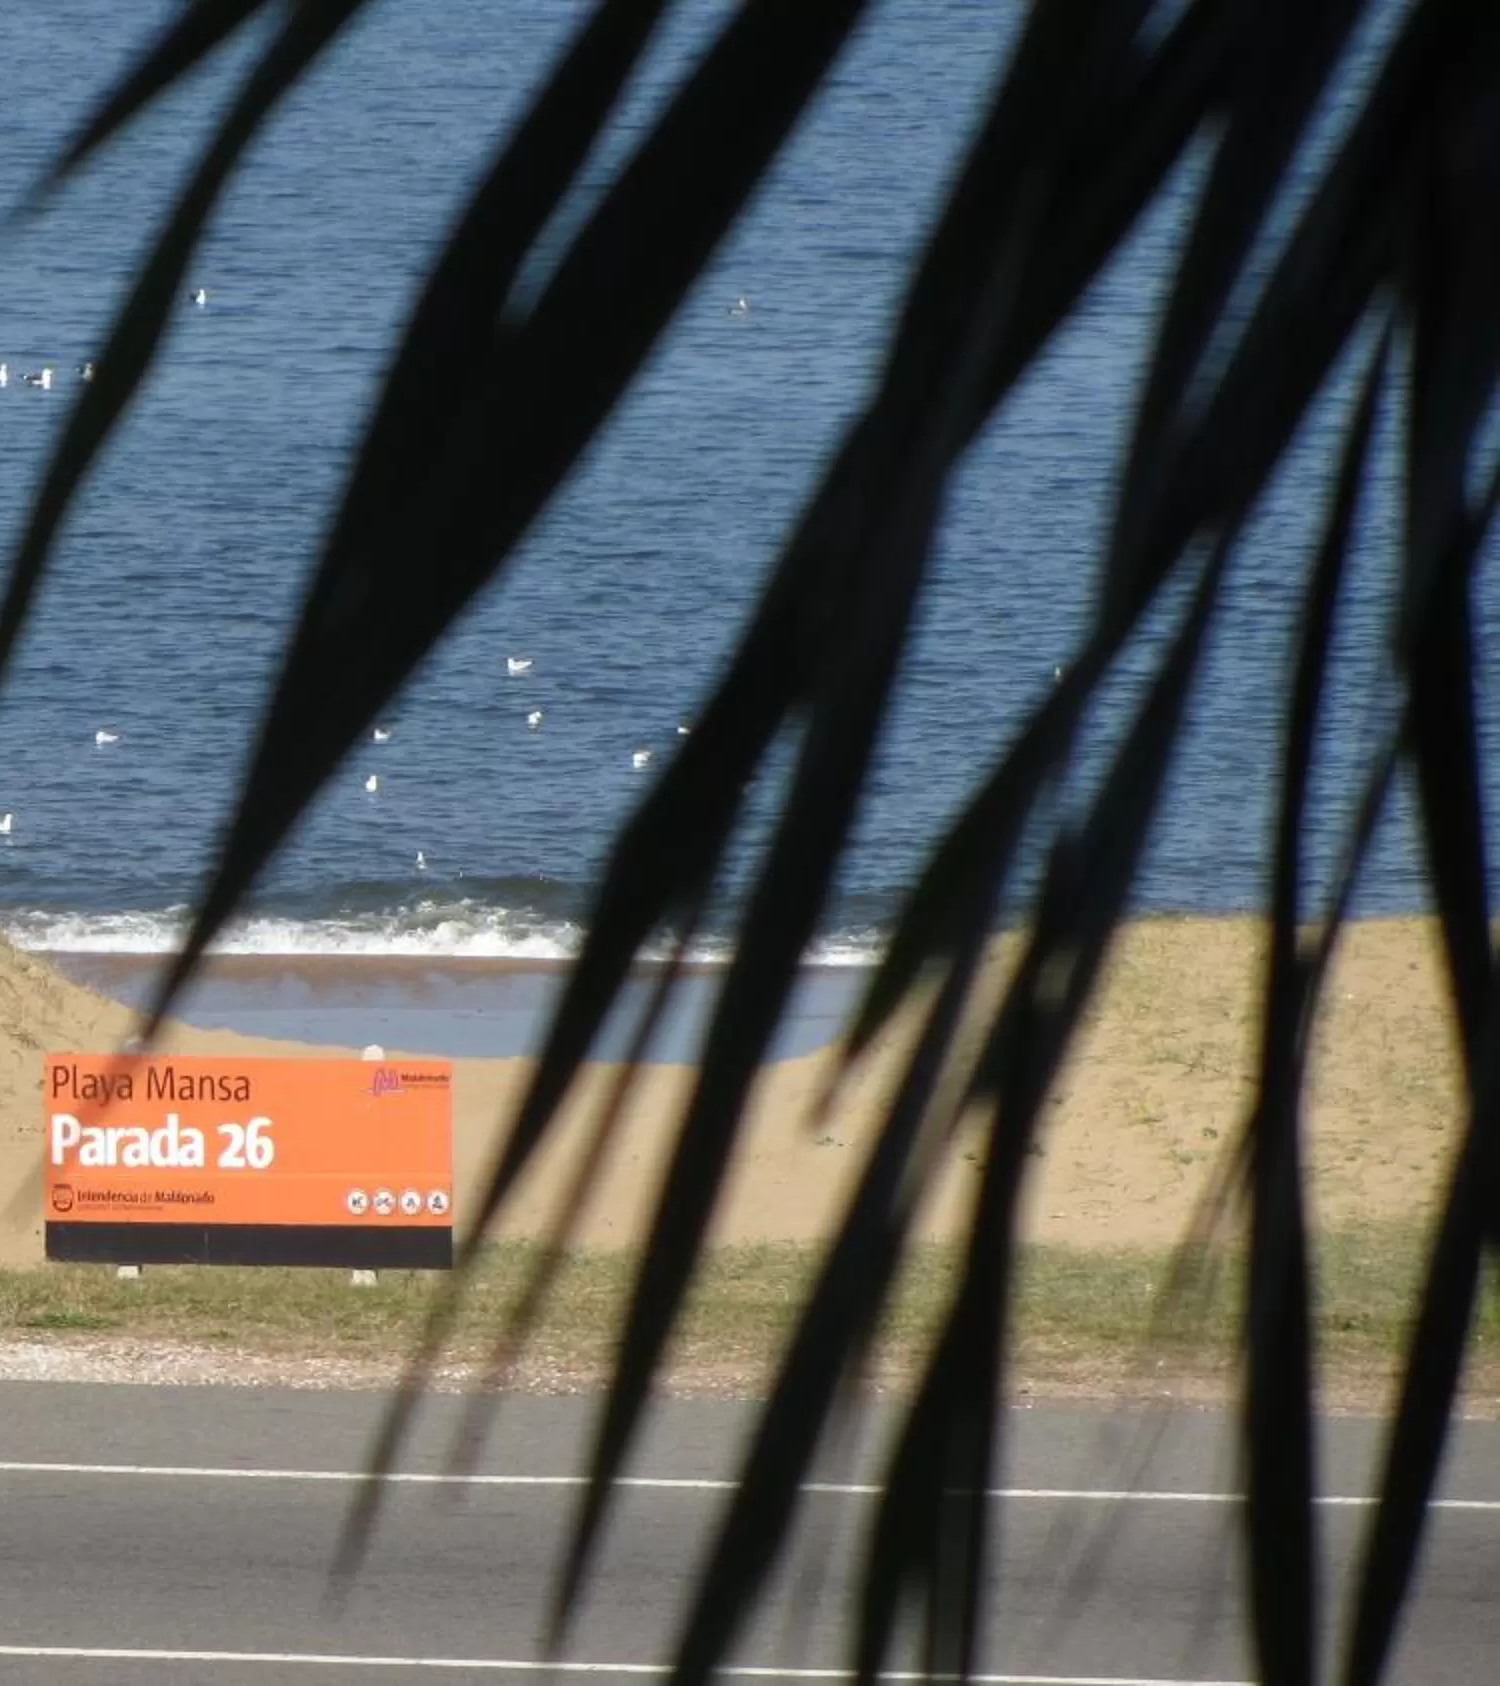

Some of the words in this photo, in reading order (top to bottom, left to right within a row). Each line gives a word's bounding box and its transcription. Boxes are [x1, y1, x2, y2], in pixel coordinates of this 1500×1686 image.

[51, 1064, 133, 1106] Playa
[147, 1066, 251, 1102] Mansa
[51, 1112, 205, 1168] Parada
[216, 1116, 275, 1169] 26
[77, 1190, 139, 1203] Intendencia
[140, 1191, 152, 1203] de
[155, 1190, 215, 1204] Maldonado
